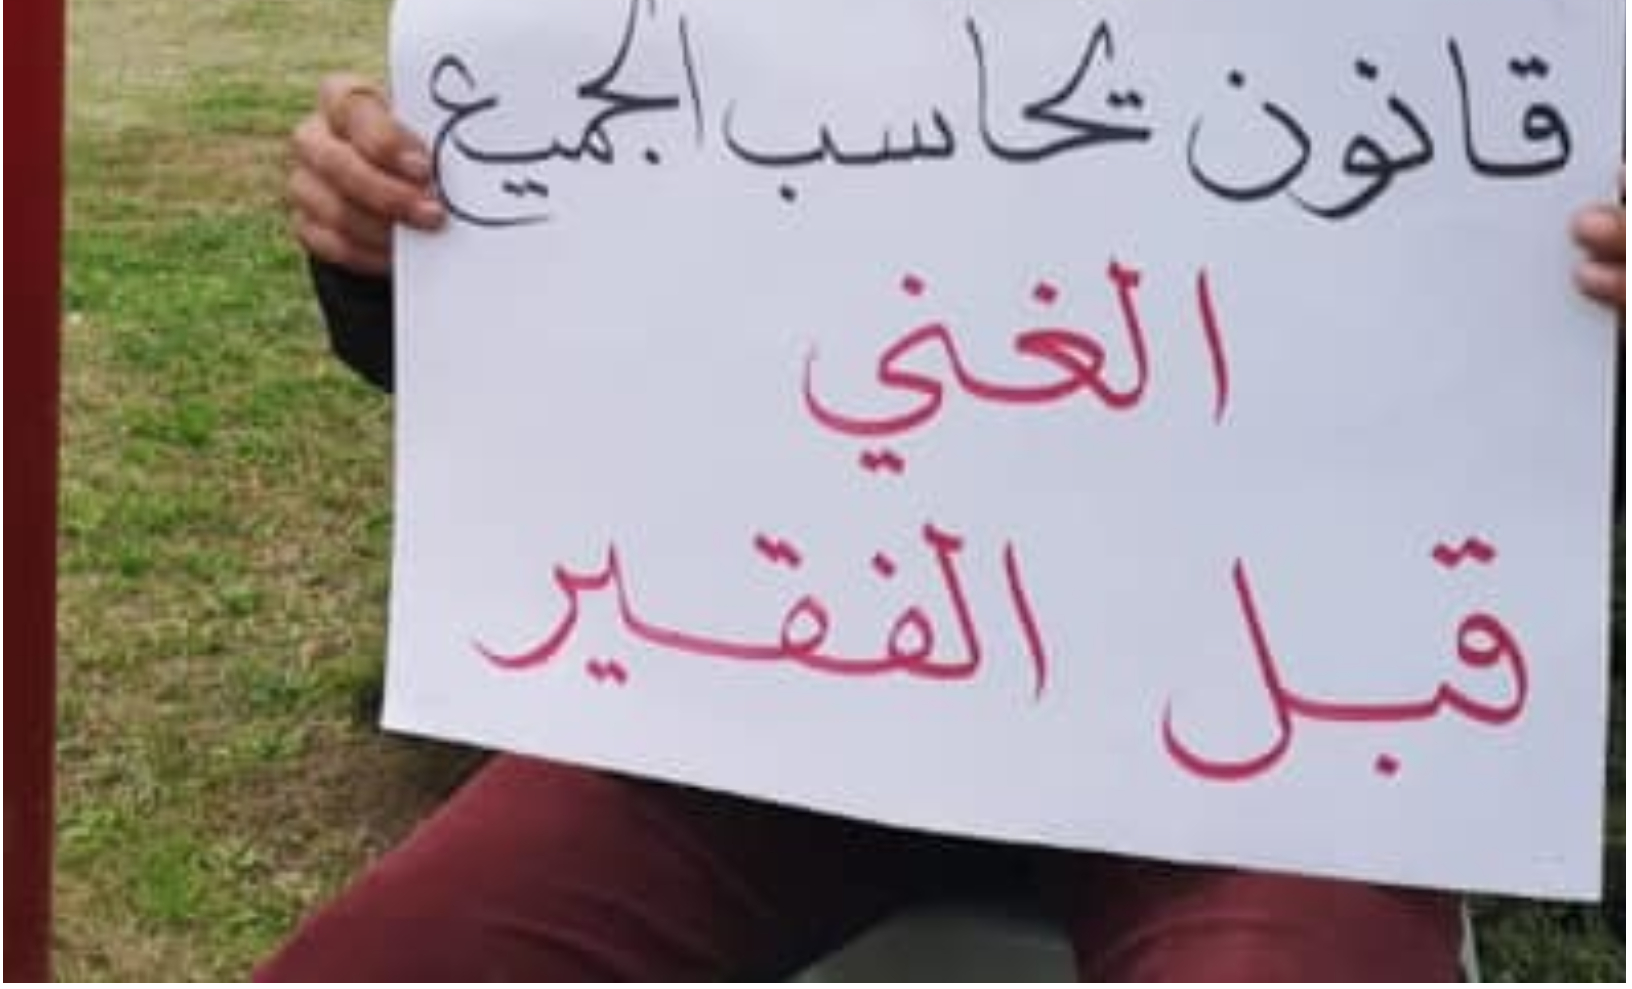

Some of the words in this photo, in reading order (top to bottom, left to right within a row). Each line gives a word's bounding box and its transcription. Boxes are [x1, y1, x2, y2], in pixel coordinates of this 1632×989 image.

[721, 18, 1154, 203] يحاسب
[1186, 36, 1574, 222] قانون
[802, 257, 1230, 475] الغني
[471, 522, 1048, 704] الفقير
[1161, 535, 1530, 782] قبل
